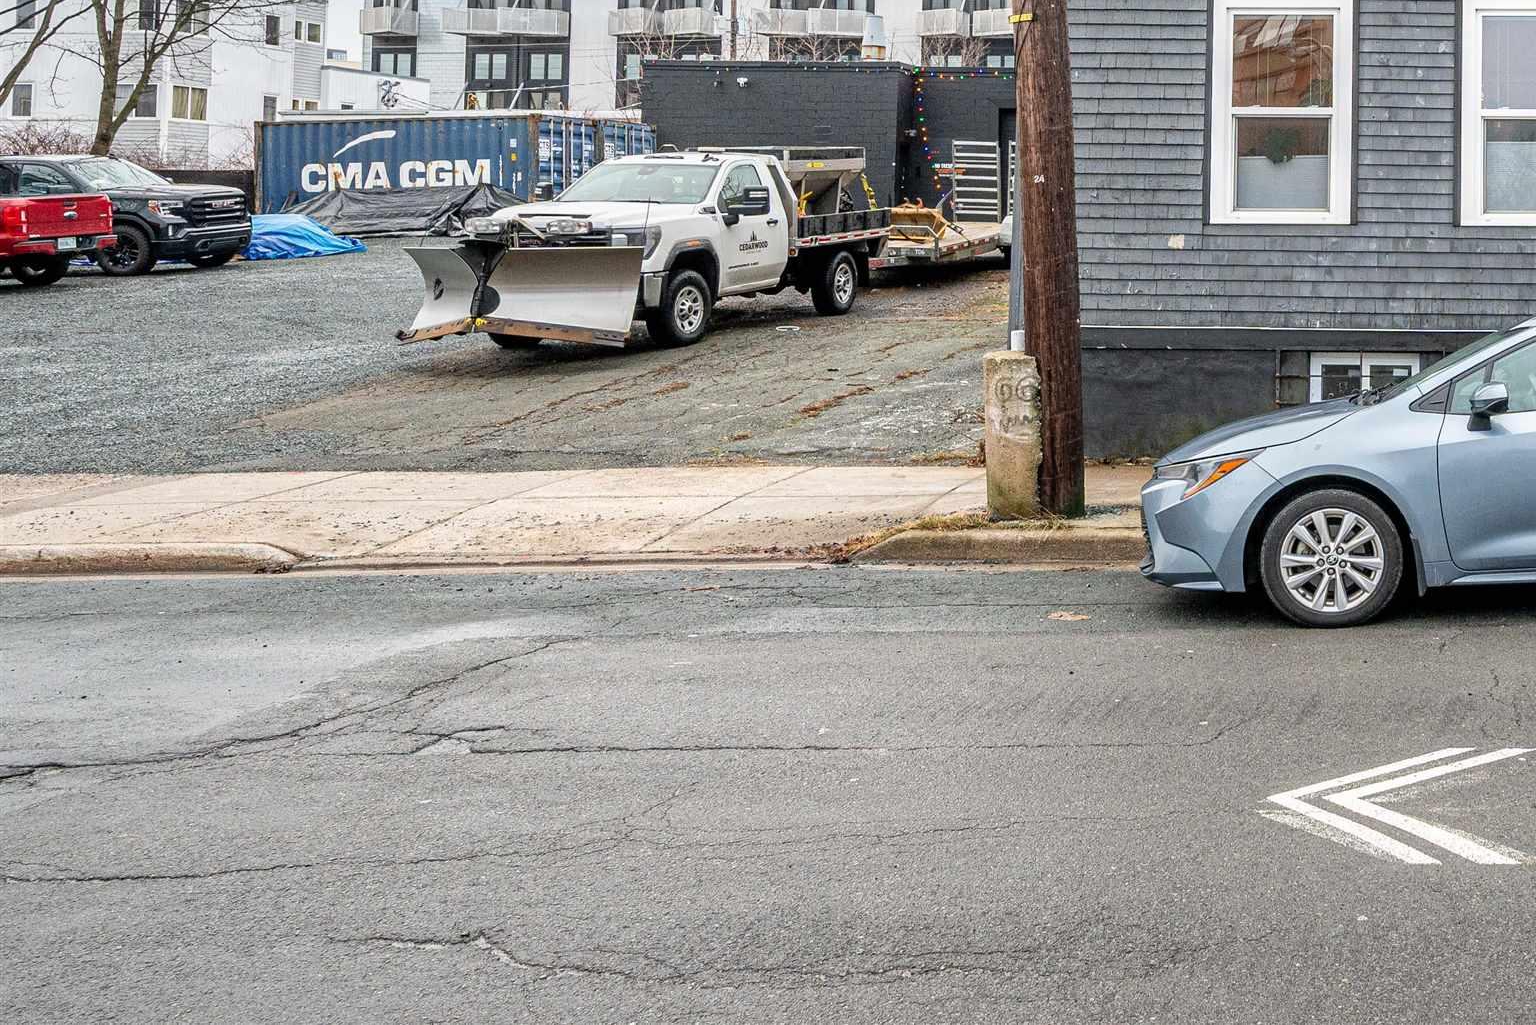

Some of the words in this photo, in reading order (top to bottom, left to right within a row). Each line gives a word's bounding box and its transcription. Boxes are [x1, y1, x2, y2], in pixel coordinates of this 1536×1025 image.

[301, 161, 391, 193] CMA
[399, 159, 491, 188] CGM
[739, 240, 769, 252] CEDARWOOD
